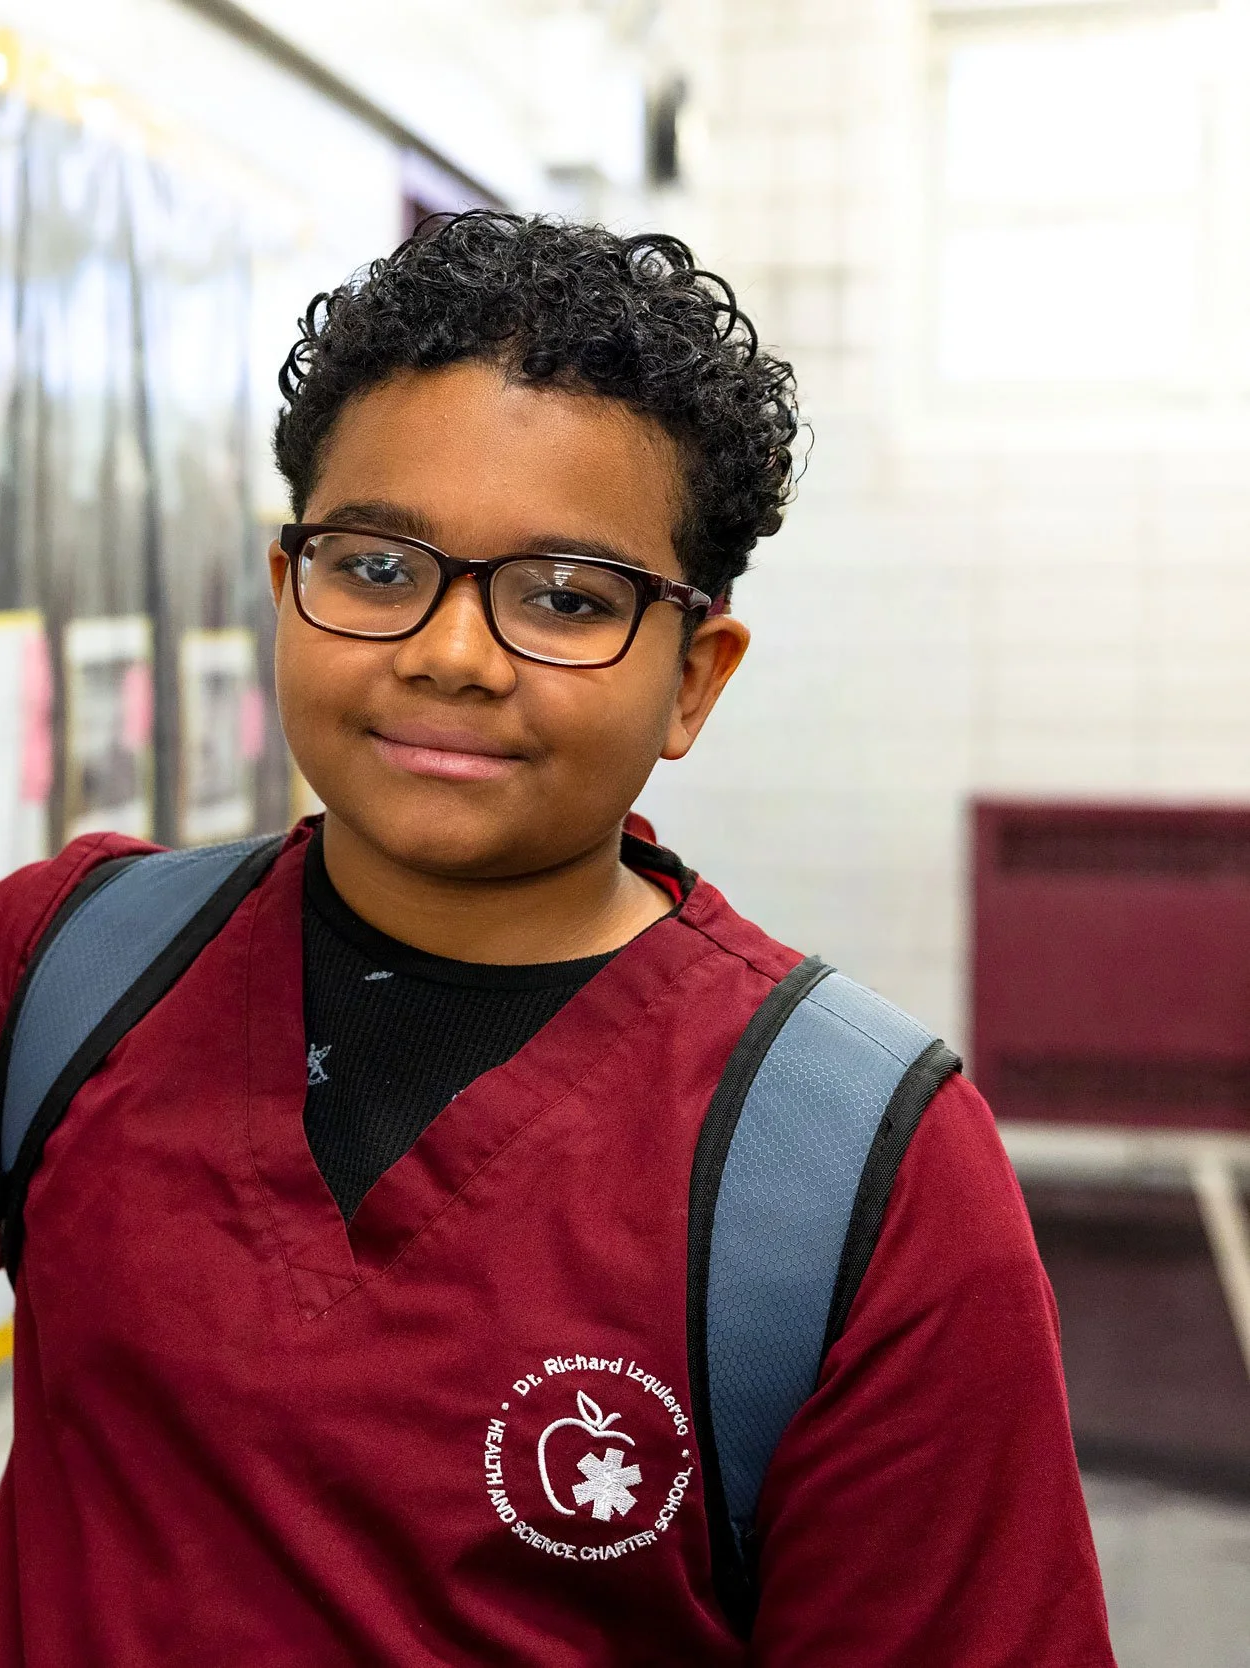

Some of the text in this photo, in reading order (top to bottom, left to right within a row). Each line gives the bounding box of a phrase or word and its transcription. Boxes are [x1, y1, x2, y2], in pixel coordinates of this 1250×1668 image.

[543, 1354, 624, 1376] Richard
[625, 1360, 689, 1437] Izquierdo
[484, 1418, 694, 1562] HEALTH AND SCIENCE CHARTER SCHOOL
